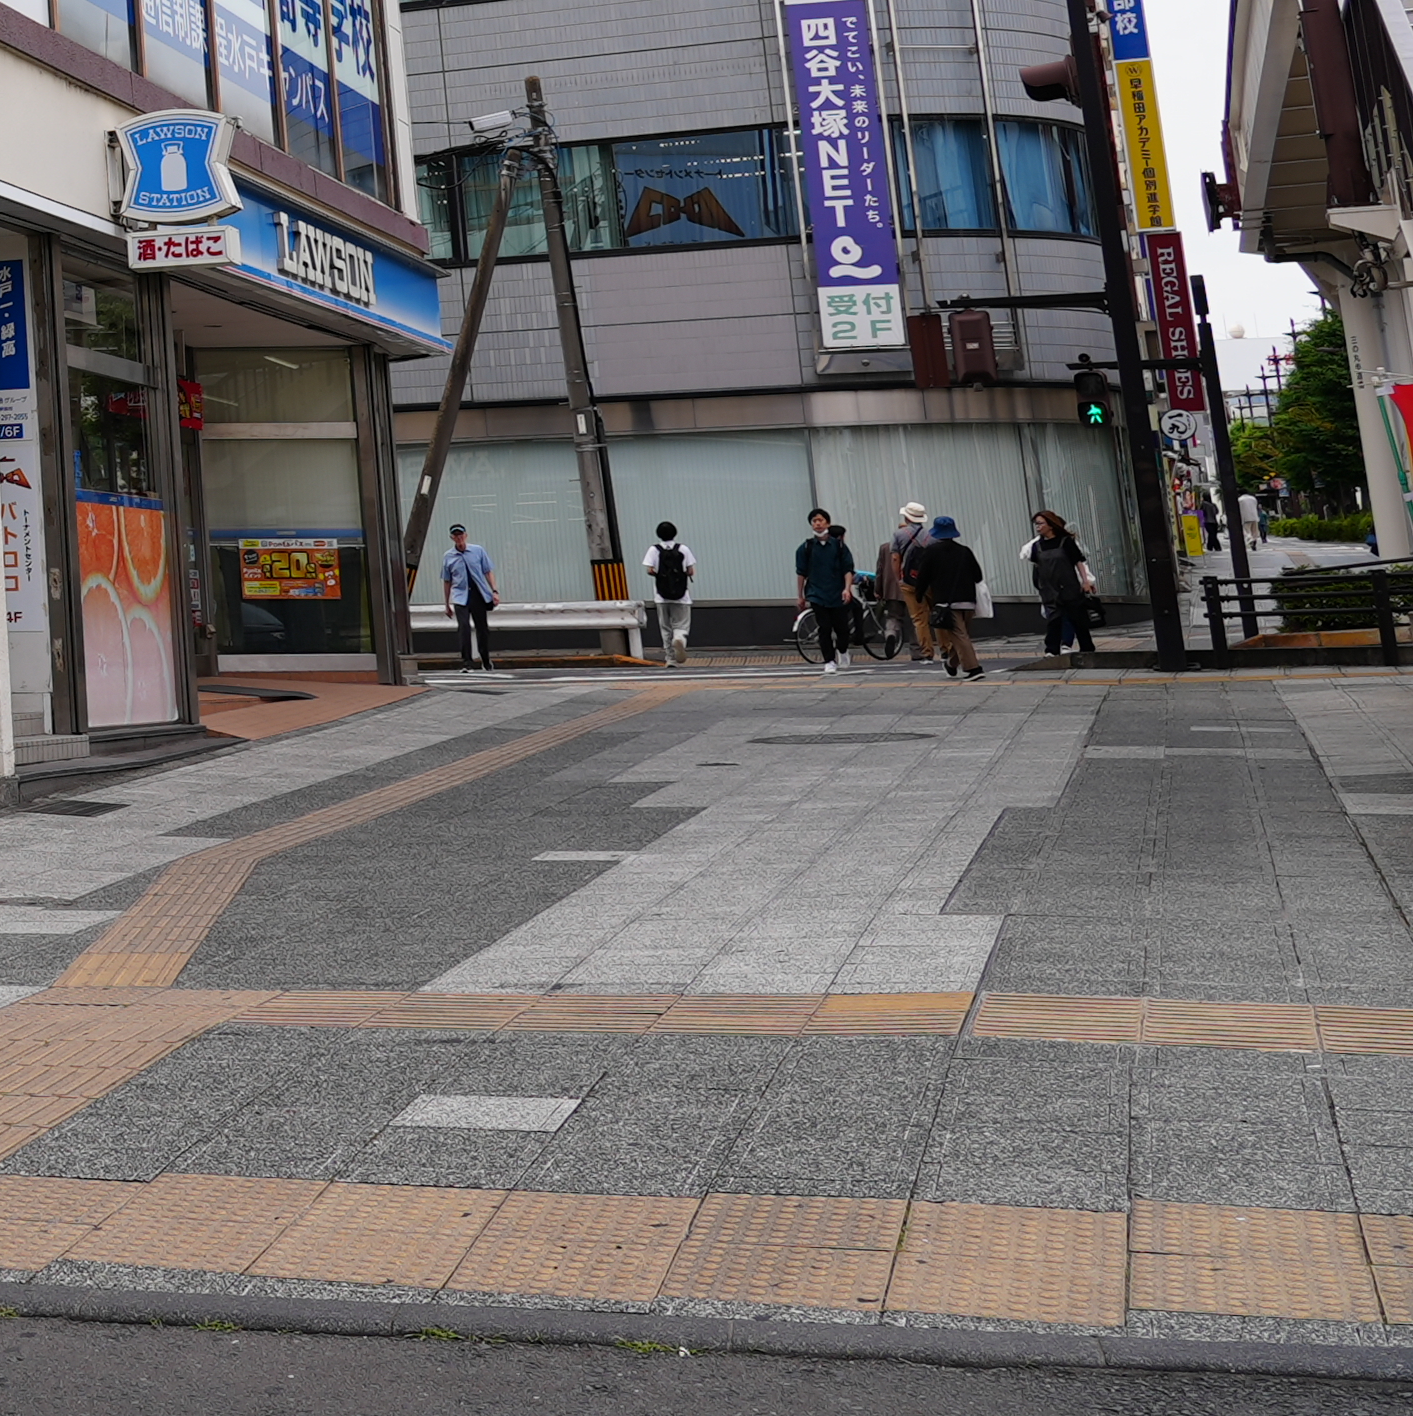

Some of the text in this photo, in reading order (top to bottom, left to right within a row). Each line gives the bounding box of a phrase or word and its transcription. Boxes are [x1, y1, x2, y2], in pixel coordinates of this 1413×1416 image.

[134, 125, 210, 145] LAWSON
[800, 16, 855, 228] 四谷大塚NET
[841, 16, 884, 229] でてこい、未来のリーダーたち。
[1129, 78, 1162, 228] 早稲田アカデミー個別進学館
[138, 186, 211, 207] STATION
[137, 234, 224, 261] 酒・たばこ
[275, 211, 377, 307] LAWSON
[826, 291, 894, 317] 受付
[1156, 246, 1194, 400] REGAL SHES
[23, 510, 31, 582] トーナメントセンター
[271, 551, 309, 578] 20
